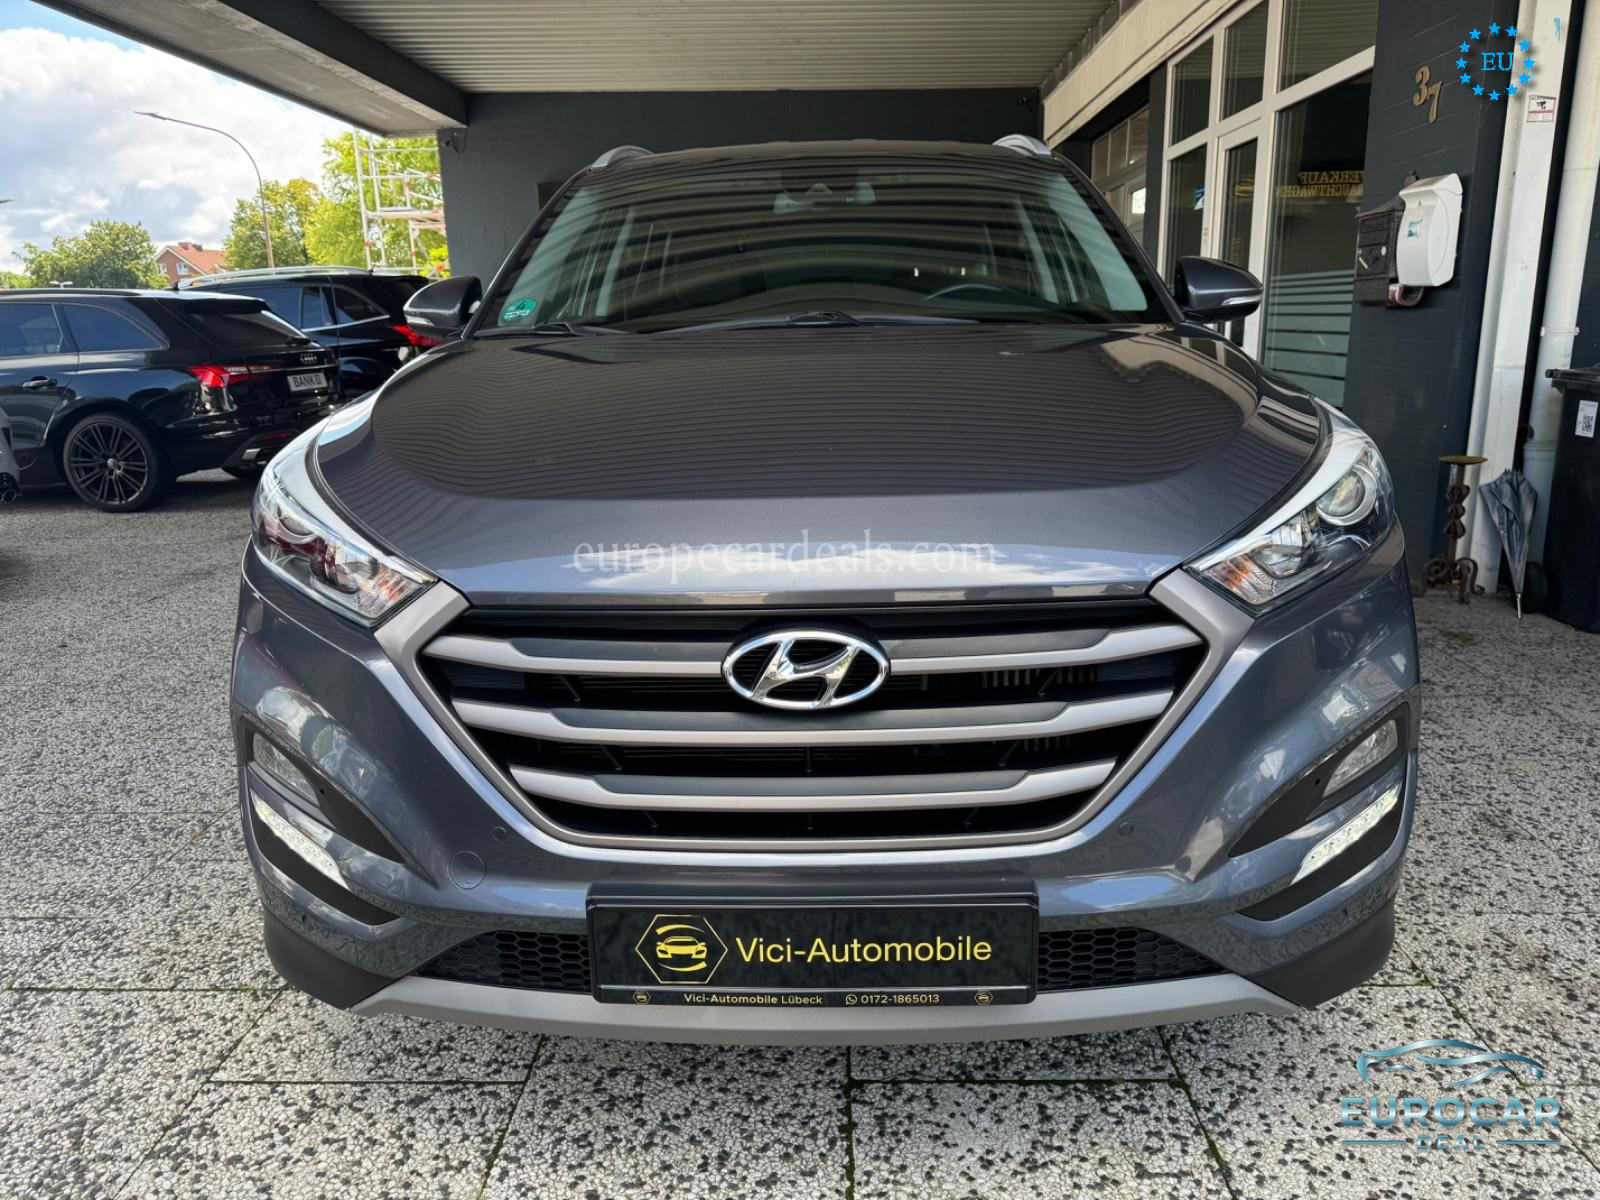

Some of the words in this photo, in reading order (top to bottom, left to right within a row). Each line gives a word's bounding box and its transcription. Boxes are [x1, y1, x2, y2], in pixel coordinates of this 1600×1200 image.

[1412, 66, 1442, 123] 37
[735, 936, 992, 963] Vici-Automobile
[684, 993, 778, 1005] Vici-Automobile
[781, 994, 823, 1005] Lübeck
[861, 994, 940, 1004] 0172-1865013
